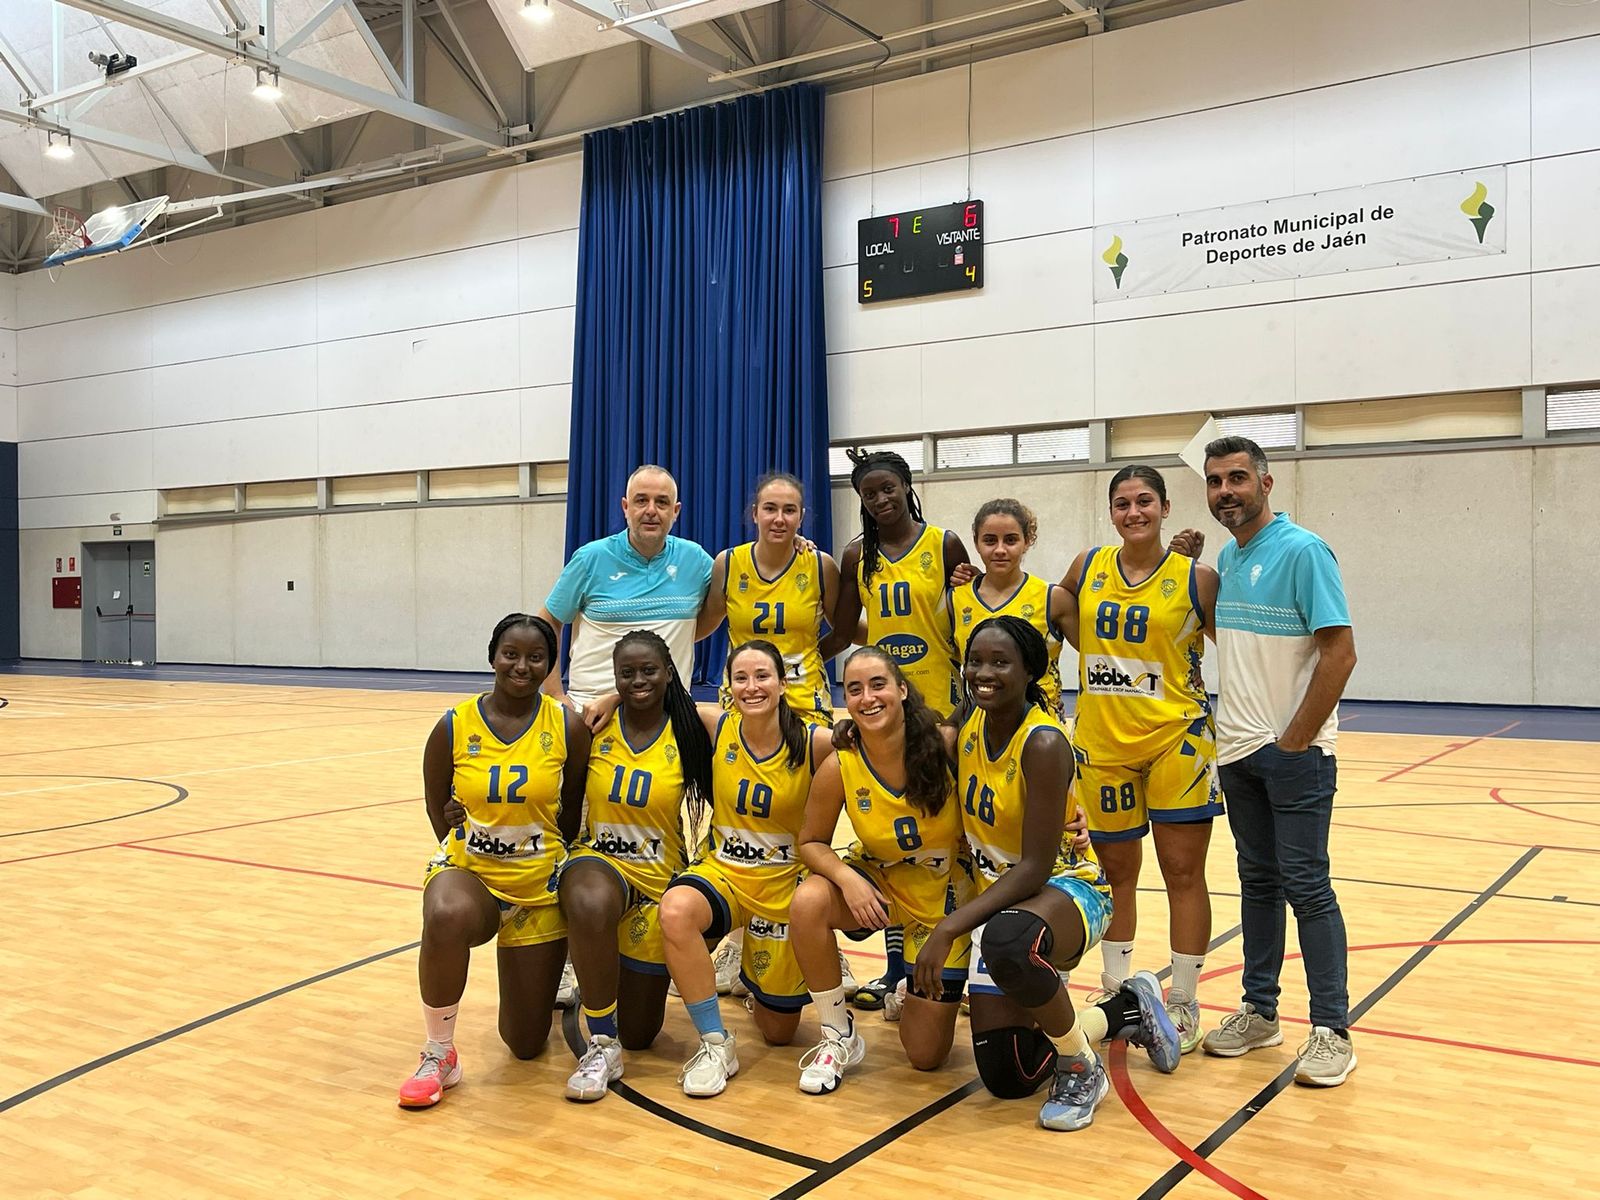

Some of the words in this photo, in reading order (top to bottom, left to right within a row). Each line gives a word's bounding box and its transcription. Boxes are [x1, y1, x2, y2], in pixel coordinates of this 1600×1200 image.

[888, 217, 899, 238] 7
[912, 216, 922, 233] E
[964, 204, 977, 227] 6
[1182, 224, 1268, 247] Patronato
[1274, 207, 1364, 235] Municipal
[1371, 205, 1394, 221] de
[865, 242, 894, 257] LOCAL
[936, 228, 980, 245] VISITANTE
[1206, 243, 1287, 264] Deportes
[1293, 238, 1315, 253] de
[1321, 230, 1366, 249] Jaén
[965, 265, 976, 282] 4
[879, 581, 912, 617] 10
[753, 602, 786, 635] 21
[1096, 600, 1150, 644] 88
[879, 644, 924, 658] Magar
[487, 765, 528, 803] 12
[608, 764, 653, 808] 10
[735, 778, 773, 818] 19
[965, 774, 995, 827] 18
[1100, 782, 1136, 813] 88
[894, 816, 923, 851] 8
